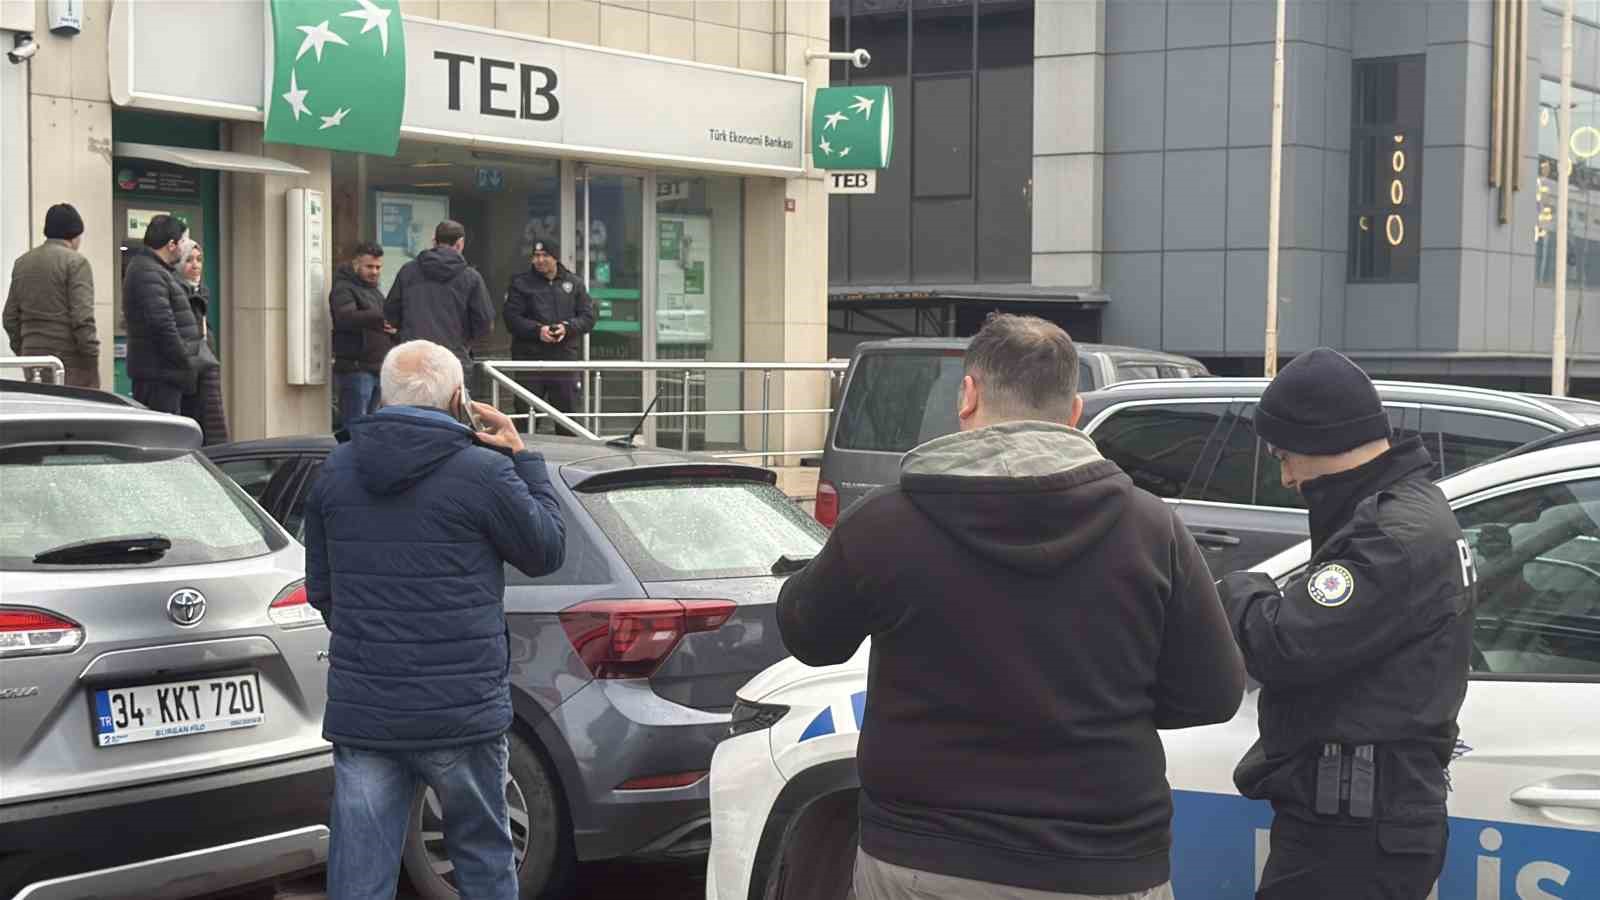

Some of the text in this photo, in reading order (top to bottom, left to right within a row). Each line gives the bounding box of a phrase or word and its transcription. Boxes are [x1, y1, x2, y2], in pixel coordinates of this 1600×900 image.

[433, 50, 560, 122] TEB
[709, 128, 793, 149] Türk Ekonomi Bankası
[831, 173, 868, 188] TEB
[112, 679, 255, 729] 34 KKT 720
[100, 716, 112, 727] TR
